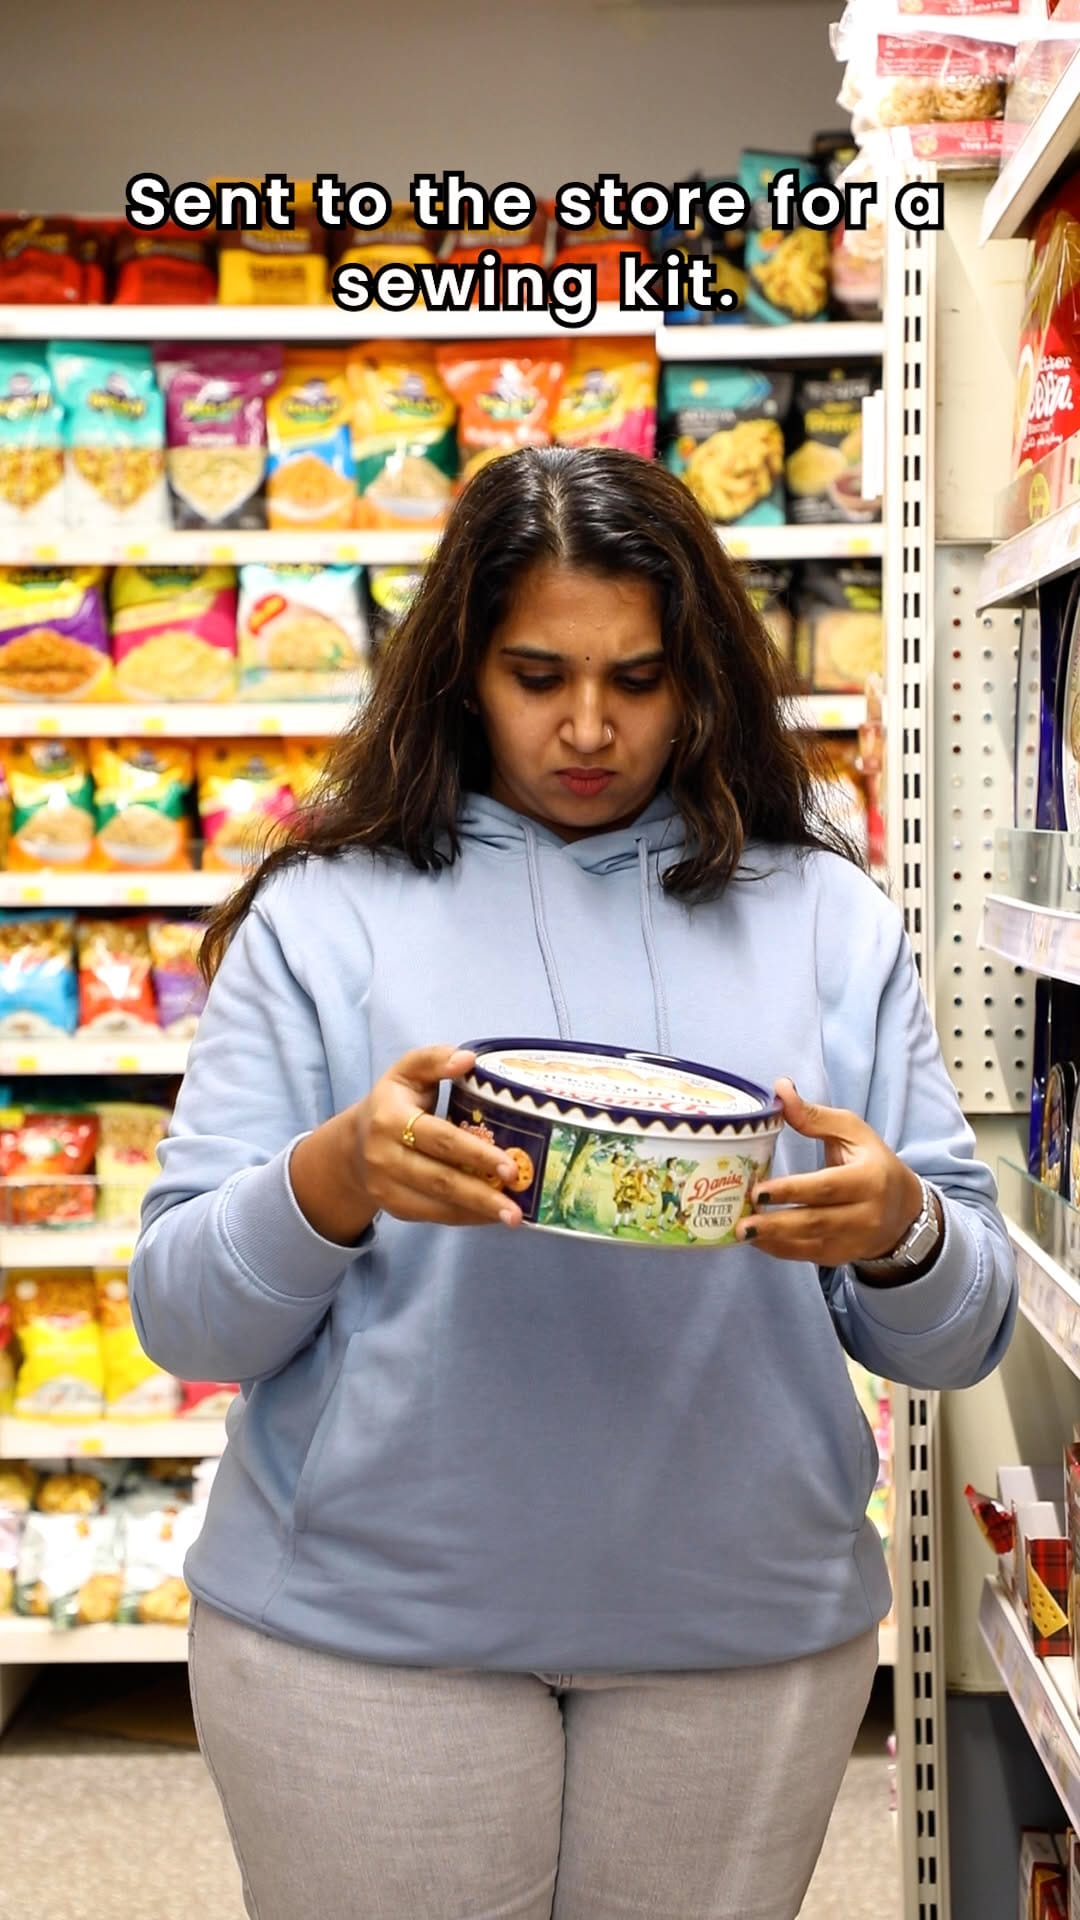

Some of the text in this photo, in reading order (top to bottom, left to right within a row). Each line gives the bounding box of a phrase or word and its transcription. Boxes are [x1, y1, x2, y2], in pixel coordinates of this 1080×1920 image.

[687, 1170, 743, 1202] Danisa
[697, 1204, 733, 1217] BUTTER
[692, 1216, 733, 1228] COOKIES
